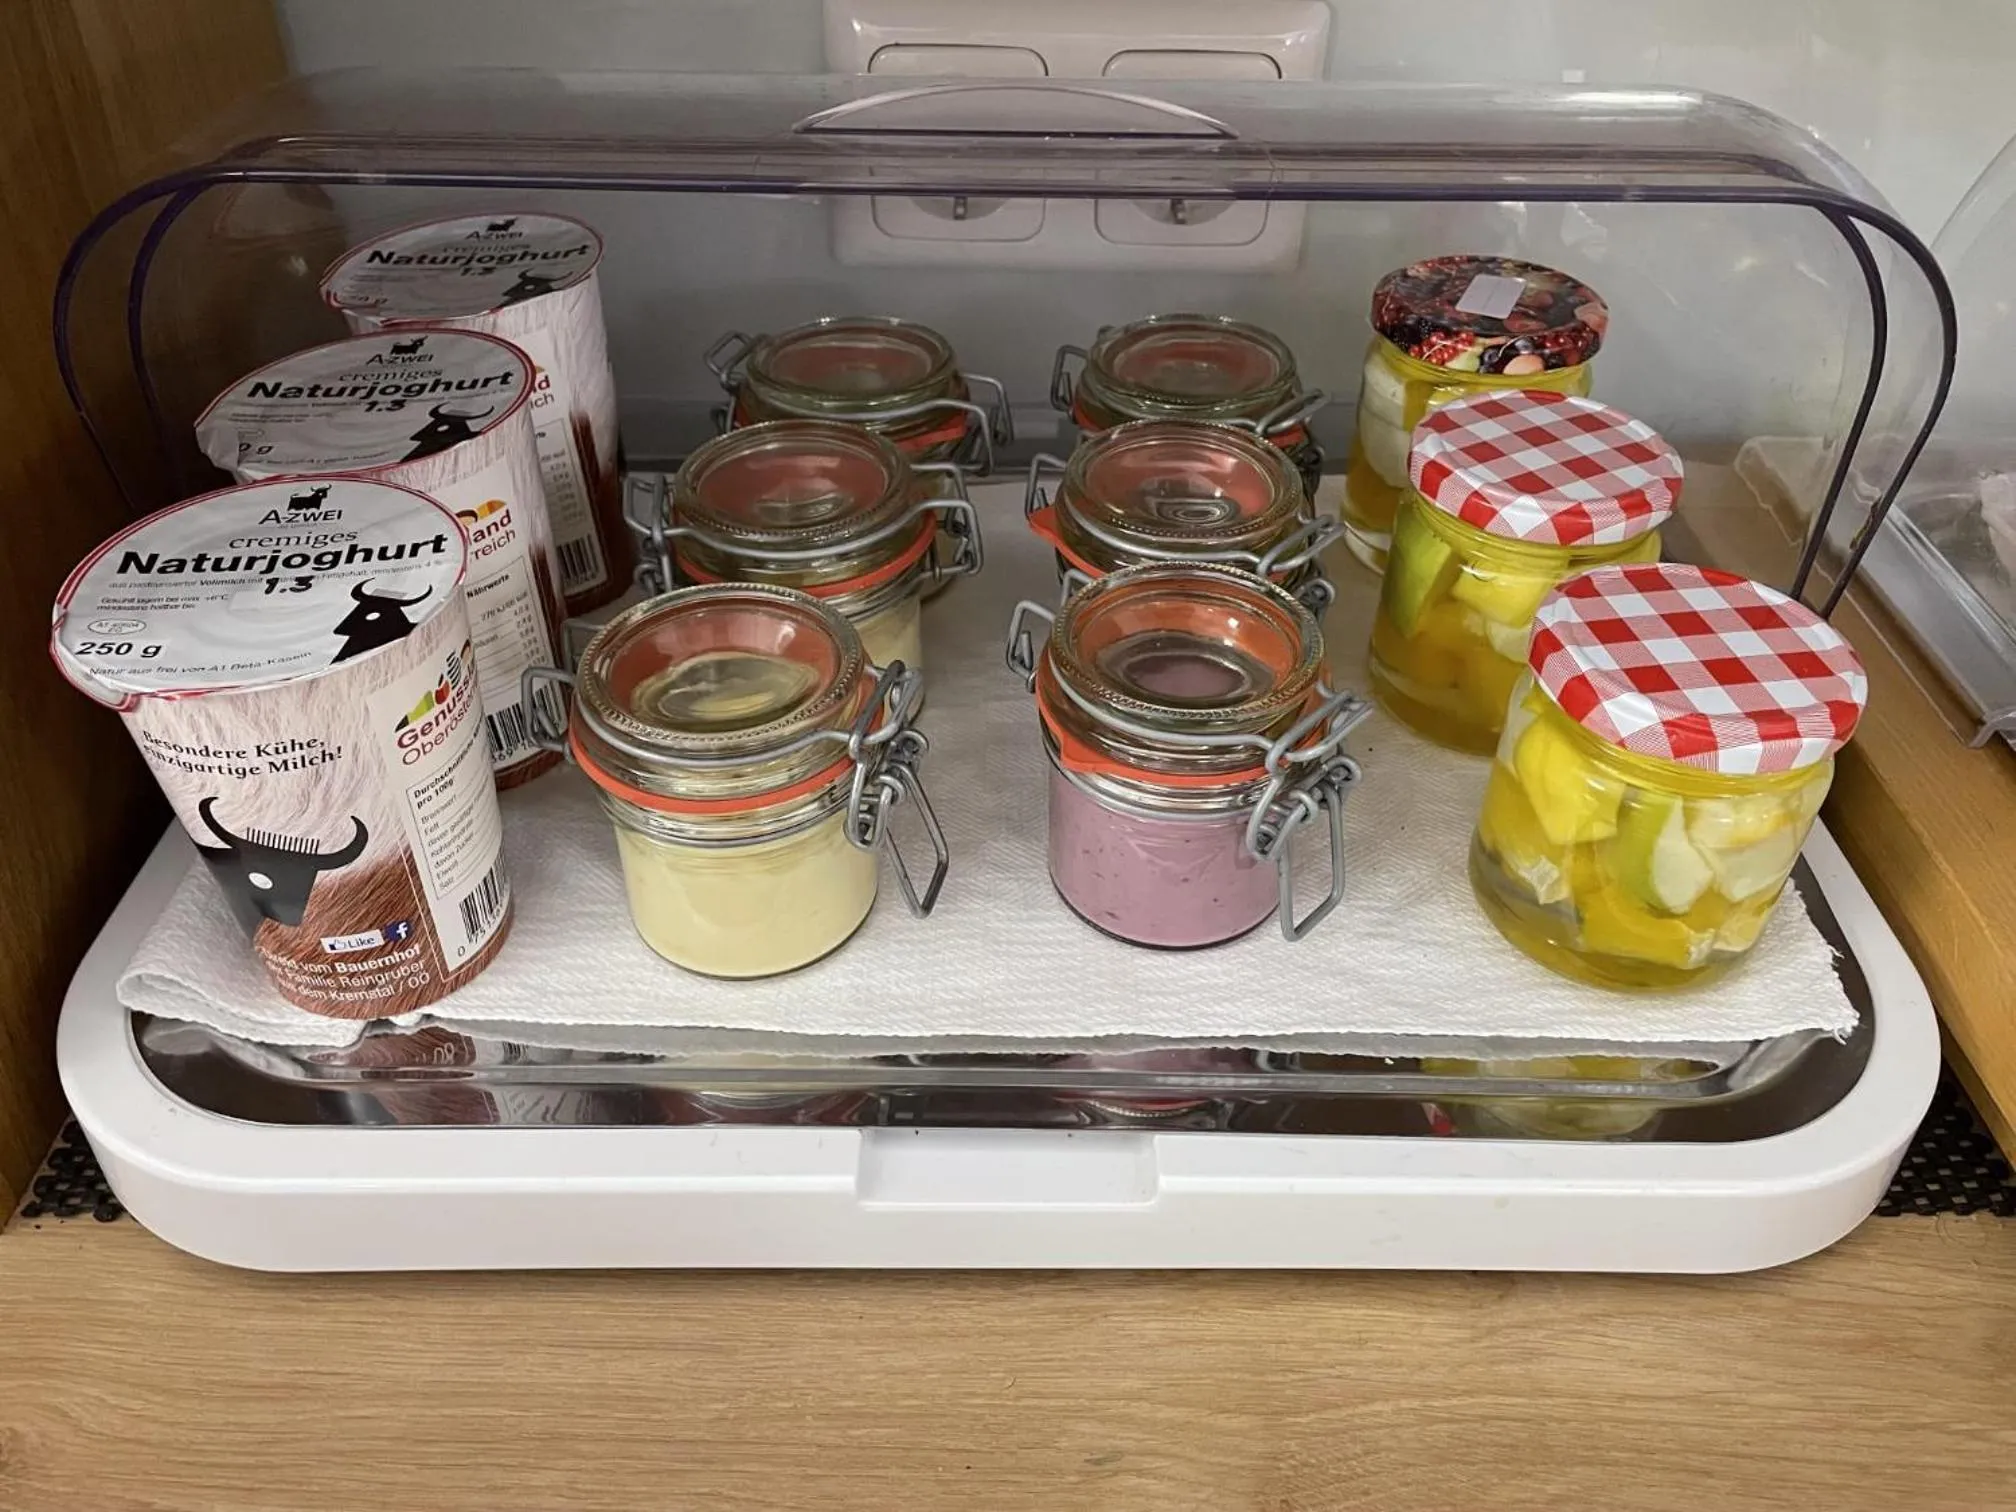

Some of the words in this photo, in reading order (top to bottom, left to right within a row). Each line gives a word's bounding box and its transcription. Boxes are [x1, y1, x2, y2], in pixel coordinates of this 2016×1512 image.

[367, 244, 590, 267] Naturjoghurt
[339, 367, 443, 383] cremiges
[247, 371, 514, 400] Naturjoghurt
[363, 400, 407, 413] 1.3
[258, 509, 343, 525] A-ZWEI
[229, 531, 358, 549] cremiges
[117, 533, 449, 575] Naturjoghurt
[264, 575, 315, 595] 1.3
[75, 642, 133, 656] 250
[140, 644, 163, 658] g
[143, 730, 249, 760] Besondere
[255, 737, 326, 758] Kühe,
[269, 745, 344, 774] Milch!
[417, 794, 433, 810] pro
[348, 935, 375, 949] Like
[300, 961, 333, 975] vom
[334, 944, 421, 974] Bauernhof
[284, 967, 337, 988] Familie
[339, 959, 427, 988] Reingruber
[331, 985, 396, 1002] Kremstal
